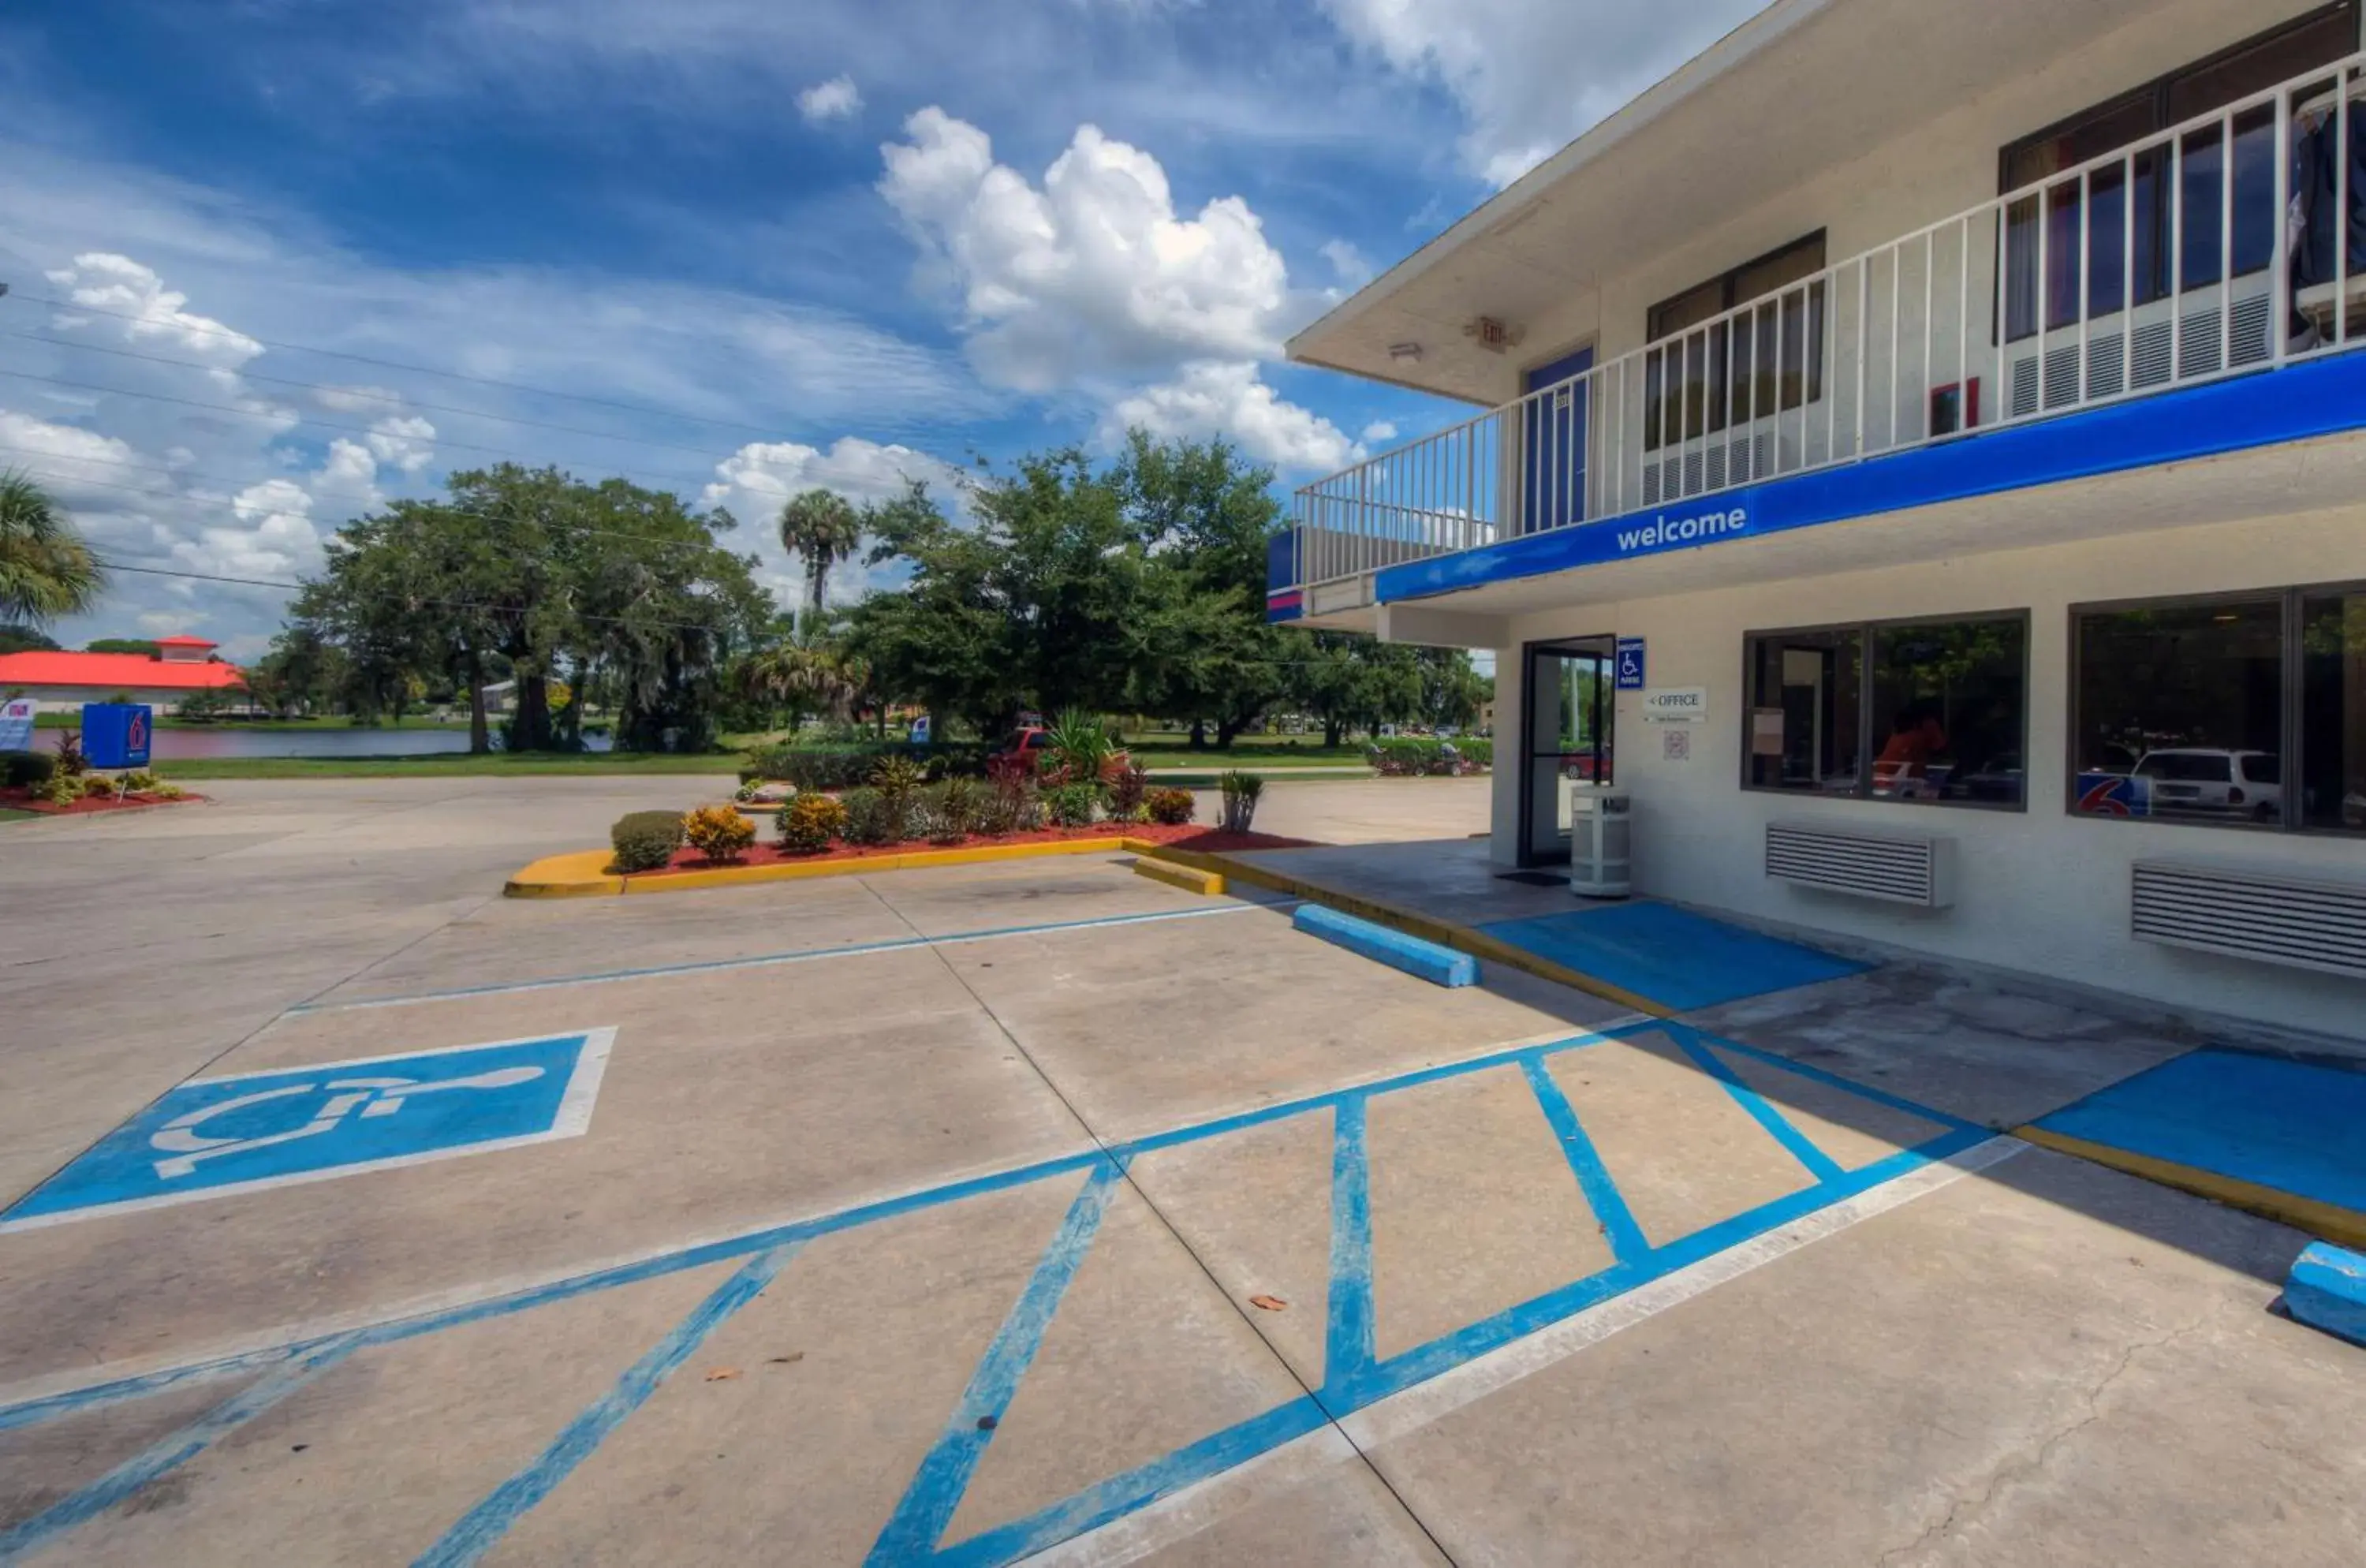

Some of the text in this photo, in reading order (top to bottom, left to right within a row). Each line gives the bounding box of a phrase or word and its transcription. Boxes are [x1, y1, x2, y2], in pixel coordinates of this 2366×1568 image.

[1618, 507, 1746, 551] welcome
[1659, 694, 1698, 707] OFFICE
[129, 712, 145, 750] 6
